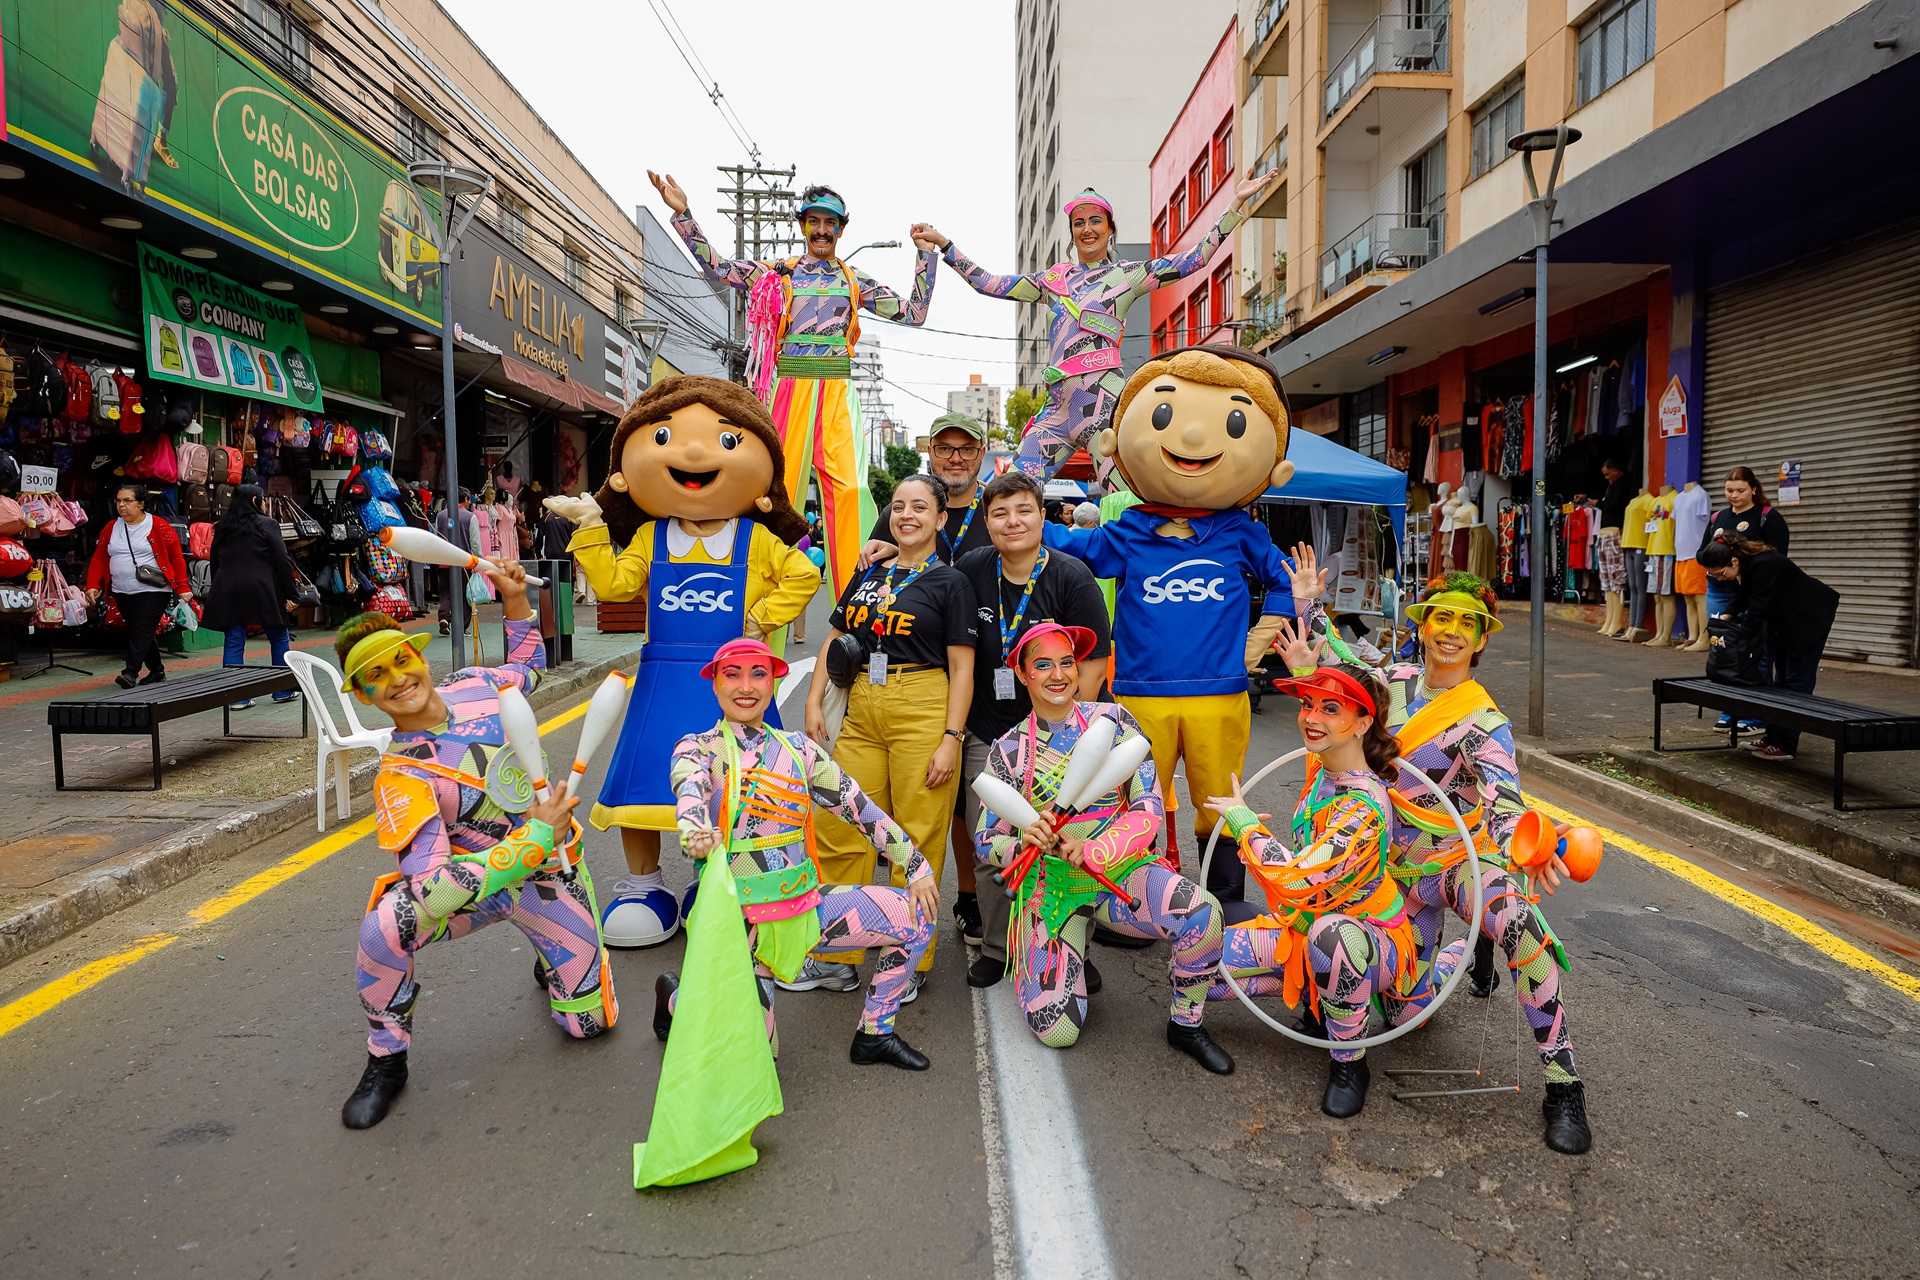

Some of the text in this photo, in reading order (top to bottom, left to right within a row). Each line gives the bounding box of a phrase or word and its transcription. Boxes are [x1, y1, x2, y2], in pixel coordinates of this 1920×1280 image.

[241, 104, 338, 192] CASA DAS
[254, 158, 331, 231] BOLSAS
[144, 252, 221, 298] COMPRE
[264, 301, 298, 326] SUA
[489, 255, 572, 355] AMELIA
[201, 302, 266, 342] COMPANY
[26, 475, 54, 486] 30,00
[658, 582, 733, 612] Sesc
[1143, 573, 1225, 604] Sesc
[845, 604, 916, 637] PATE
